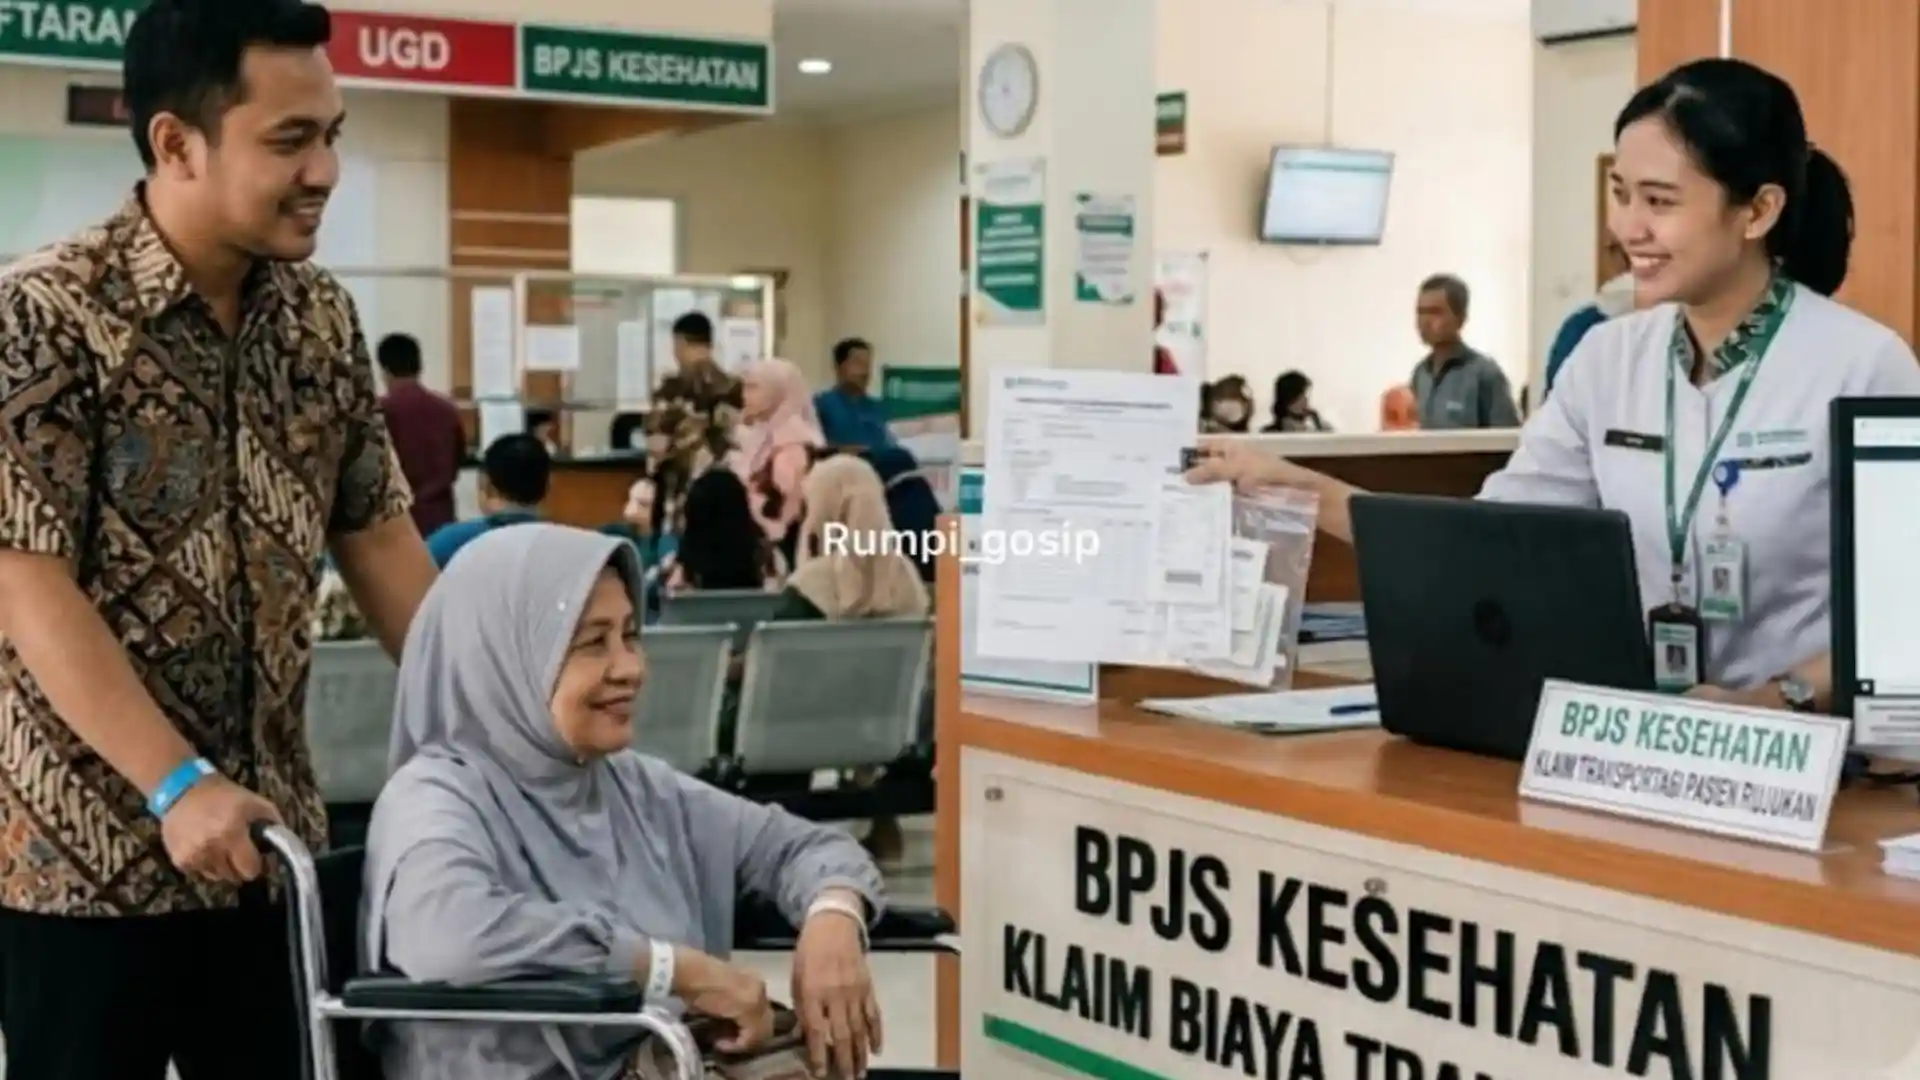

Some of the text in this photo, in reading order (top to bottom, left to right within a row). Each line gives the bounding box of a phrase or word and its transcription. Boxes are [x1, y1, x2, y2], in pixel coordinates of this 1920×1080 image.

[0, 1, 137, 47] FTARA
[359, 27, 450, 70] UGD
[533, 45, 759, 90] BPJS KESEHATAN
[1561, 701, 1811, 772] BPJS KESEHATAN
[1075, 825, 1773, 1080] BPJS KESEHATAN
[1004, 924, 1151, 1040] KLAIM
[1169, 975, 1325, 1080] BIAYA
